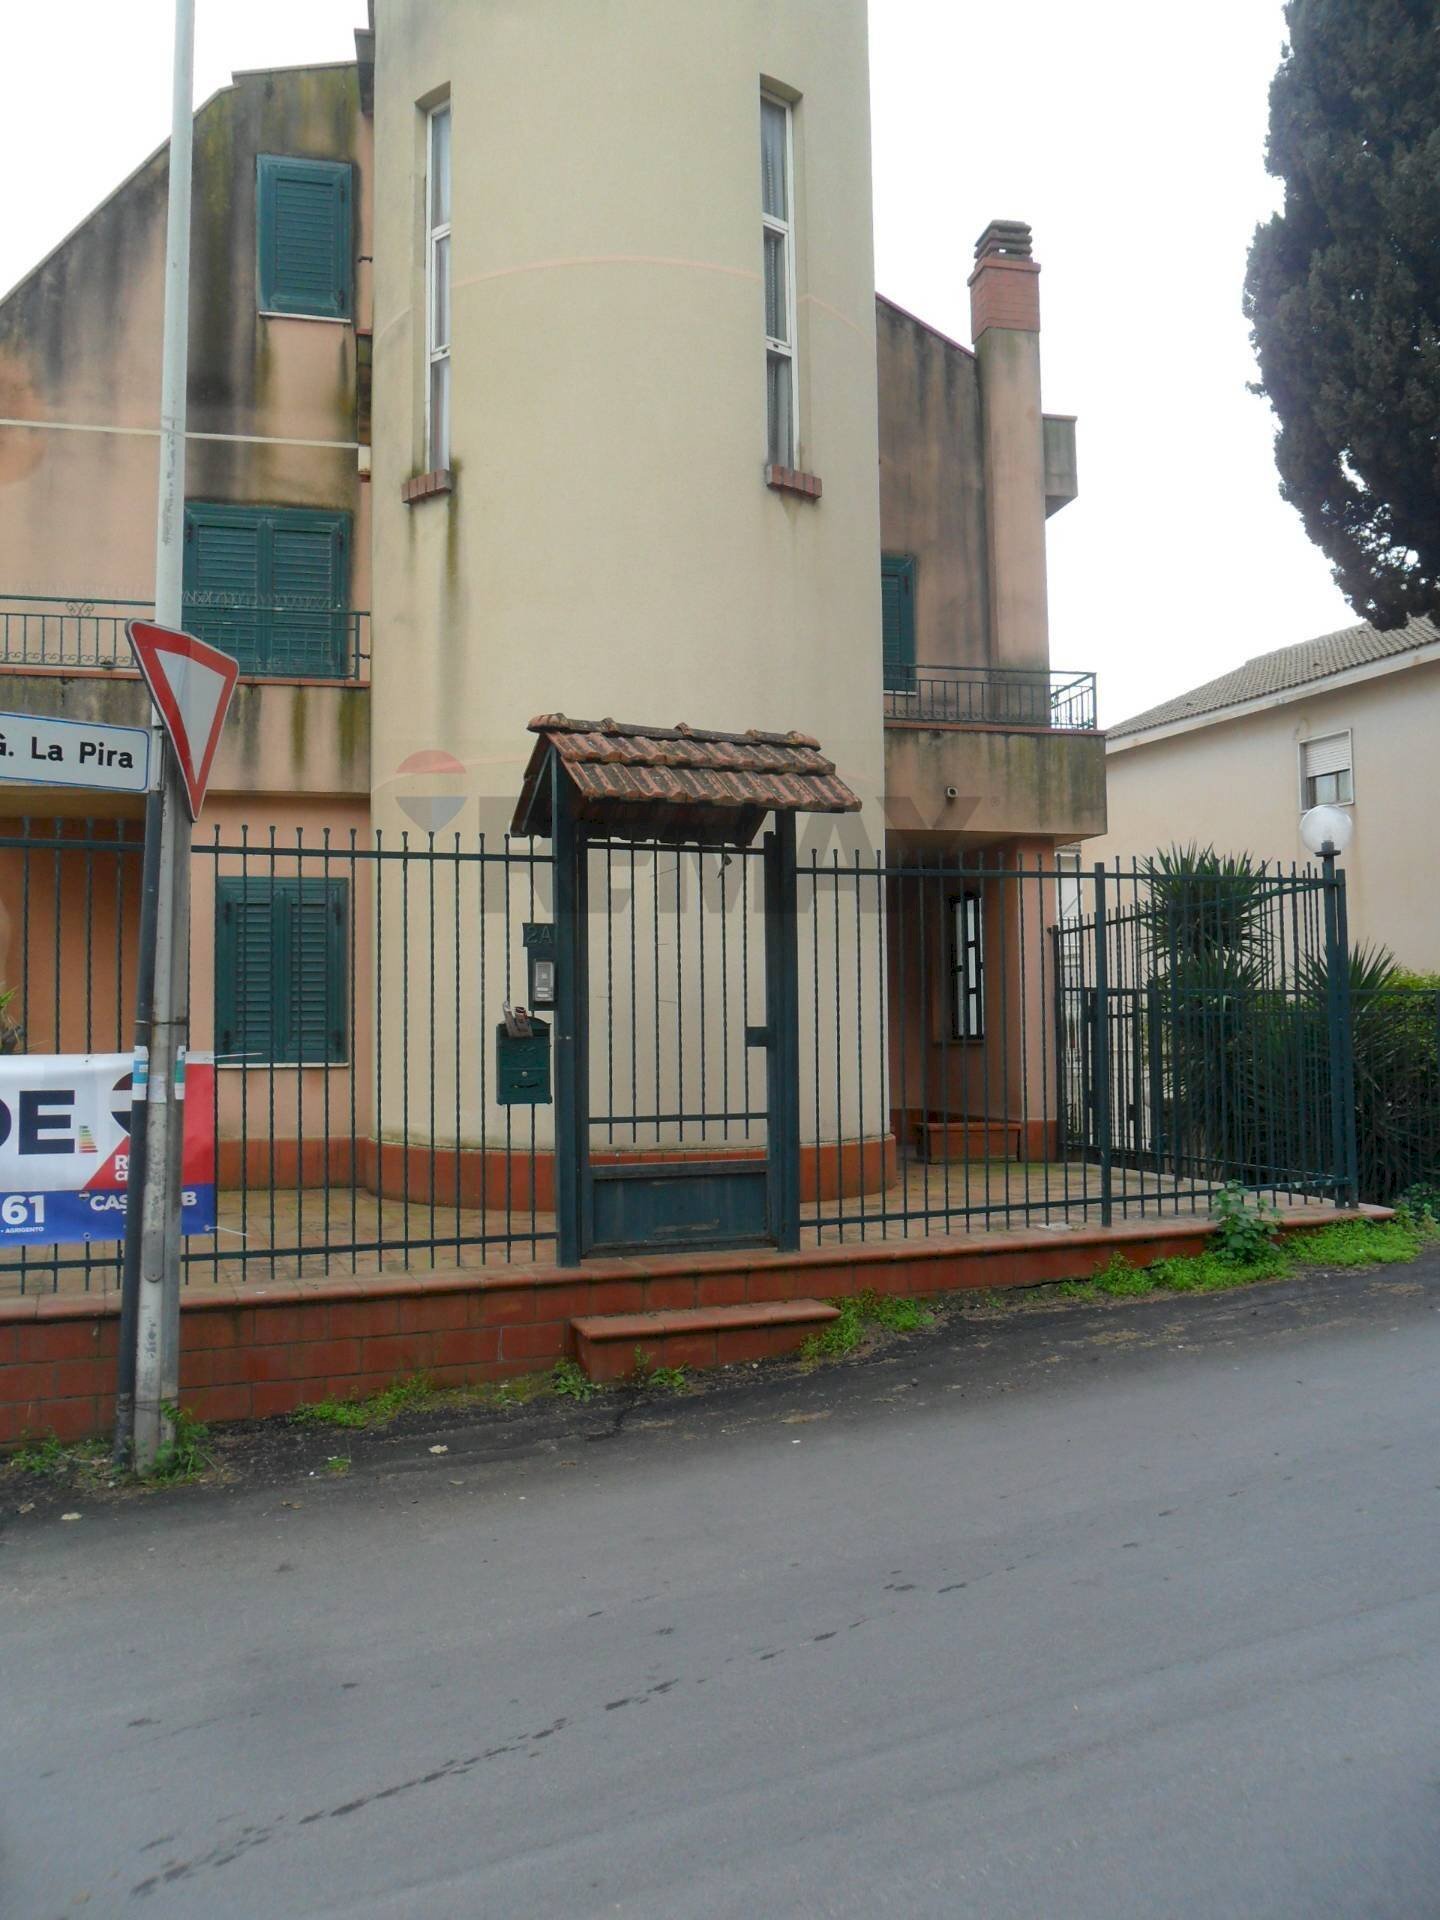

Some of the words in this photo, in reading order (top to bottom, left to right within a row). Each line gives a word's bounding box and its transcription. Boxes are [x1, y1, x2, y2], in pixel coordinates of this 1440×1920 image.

[31, 736, 63, 762] La
[79, 741, 134, 769] Pira
[526, 926, 553, 944] 2A
[2, 1194, 45, 1225] 61
[5, 1226, 45, 1234] AGRIGENTO
